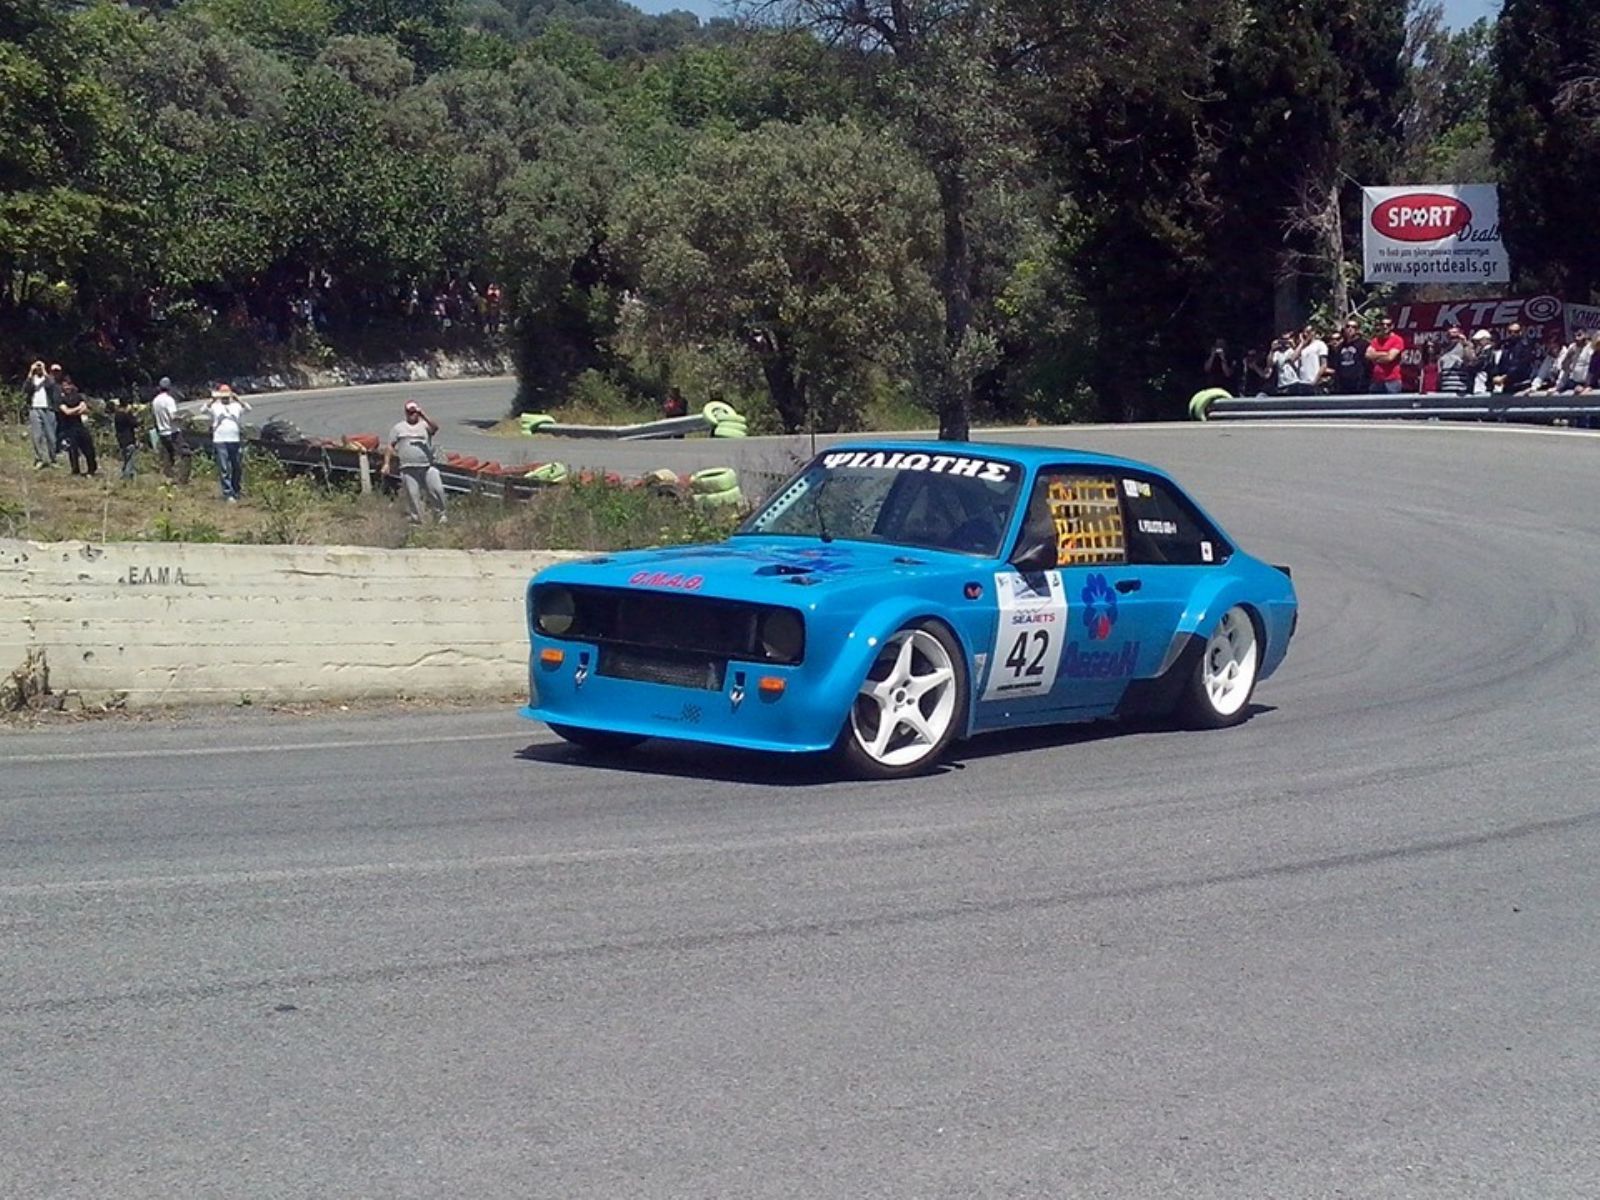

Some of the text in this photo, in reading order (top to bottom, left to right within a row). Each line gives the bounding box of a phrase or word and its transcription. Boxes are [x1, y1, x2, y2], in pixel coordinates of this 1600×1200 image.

[1388, 206, 1457, 227] SPORT
[1457, 223, 1500, 242] Deals
[1373, 257, 1498, 277] www.sportdeals.gr
[823, 452, 1010, 482] ΨΙΛΙΩΤΗΣ
[1012, 612, 1055, 625] SEAJETS
[1005, 629, 1049, 677] 42
